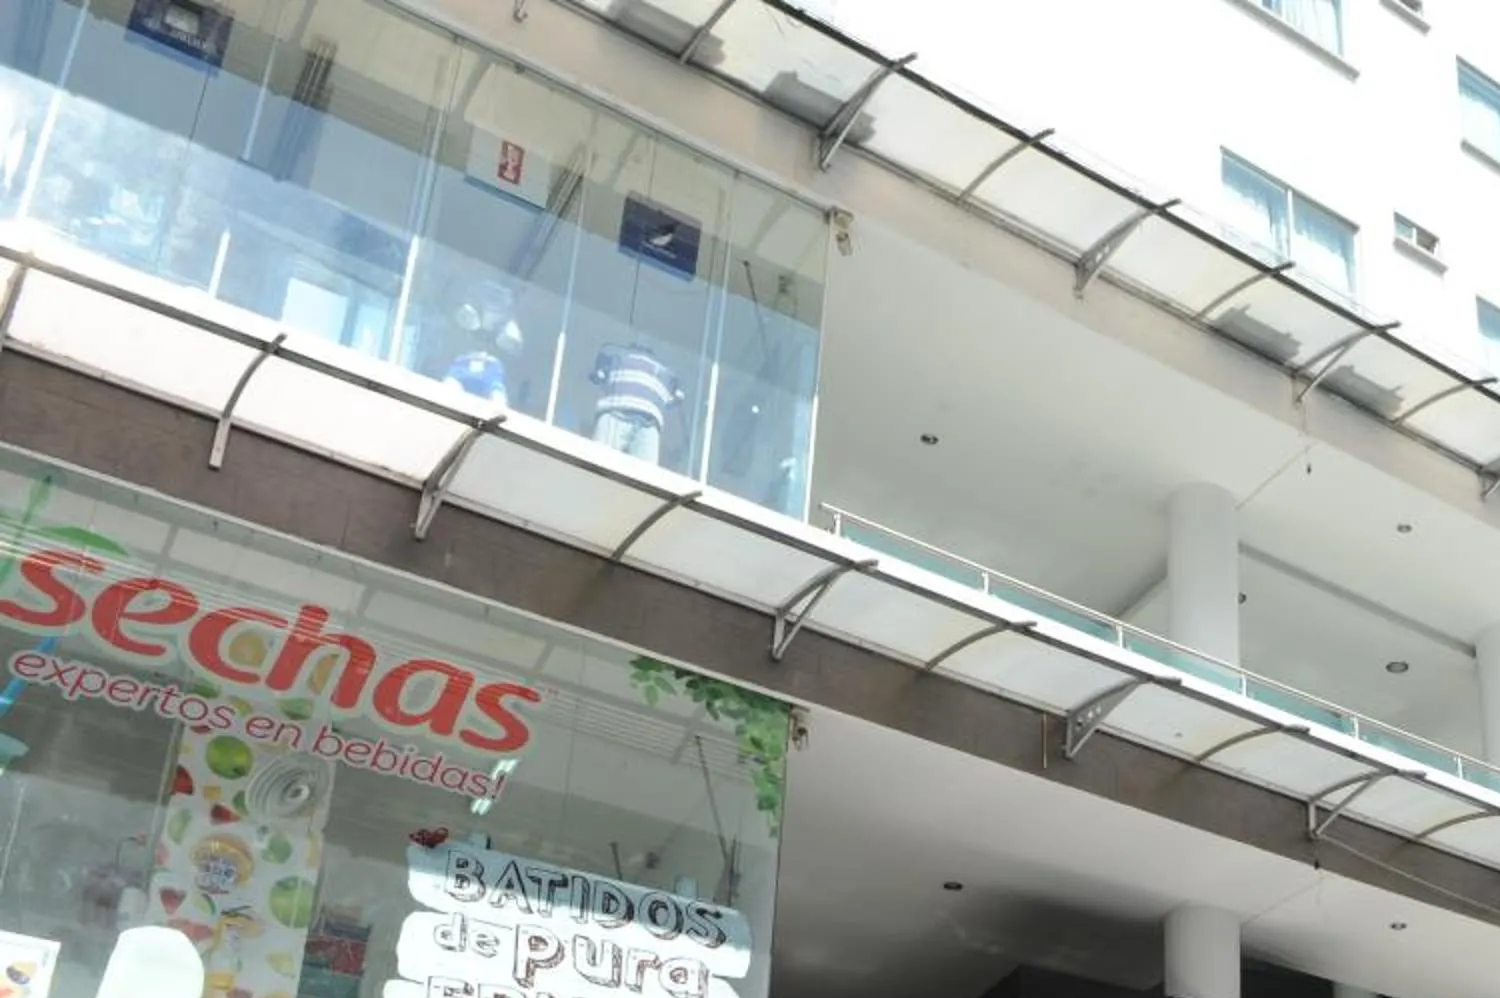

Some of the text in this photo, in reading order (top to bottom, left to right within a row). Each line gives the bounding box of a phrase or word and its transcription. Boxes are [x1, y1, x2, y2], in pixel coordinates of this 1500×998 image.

[13, 653, 508, 799] expertos en bebidas!
[432, 912, 501, 959] de
[443, 849, 728, 949] BATIDOS
